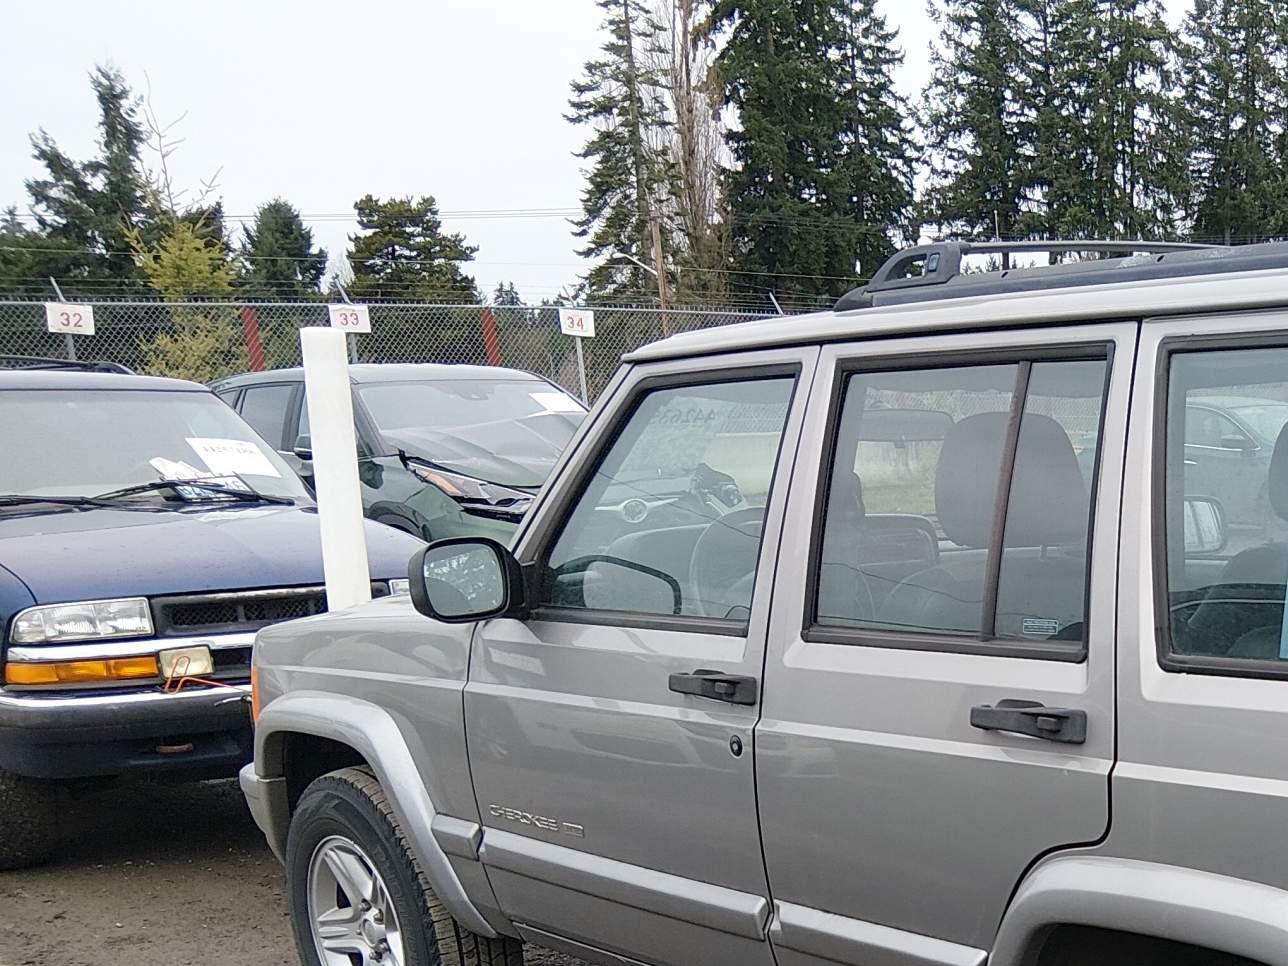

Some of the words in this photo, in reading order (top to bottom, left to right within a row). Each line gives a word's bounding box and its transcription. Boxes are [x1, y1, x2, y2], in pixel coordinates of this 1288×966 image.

[60, 312, 83, 328] 32
[339, 312, 359, 326] 33
[567, 316, 584, 331] 34
[489, 804, 559, 831] CHEROKEE
